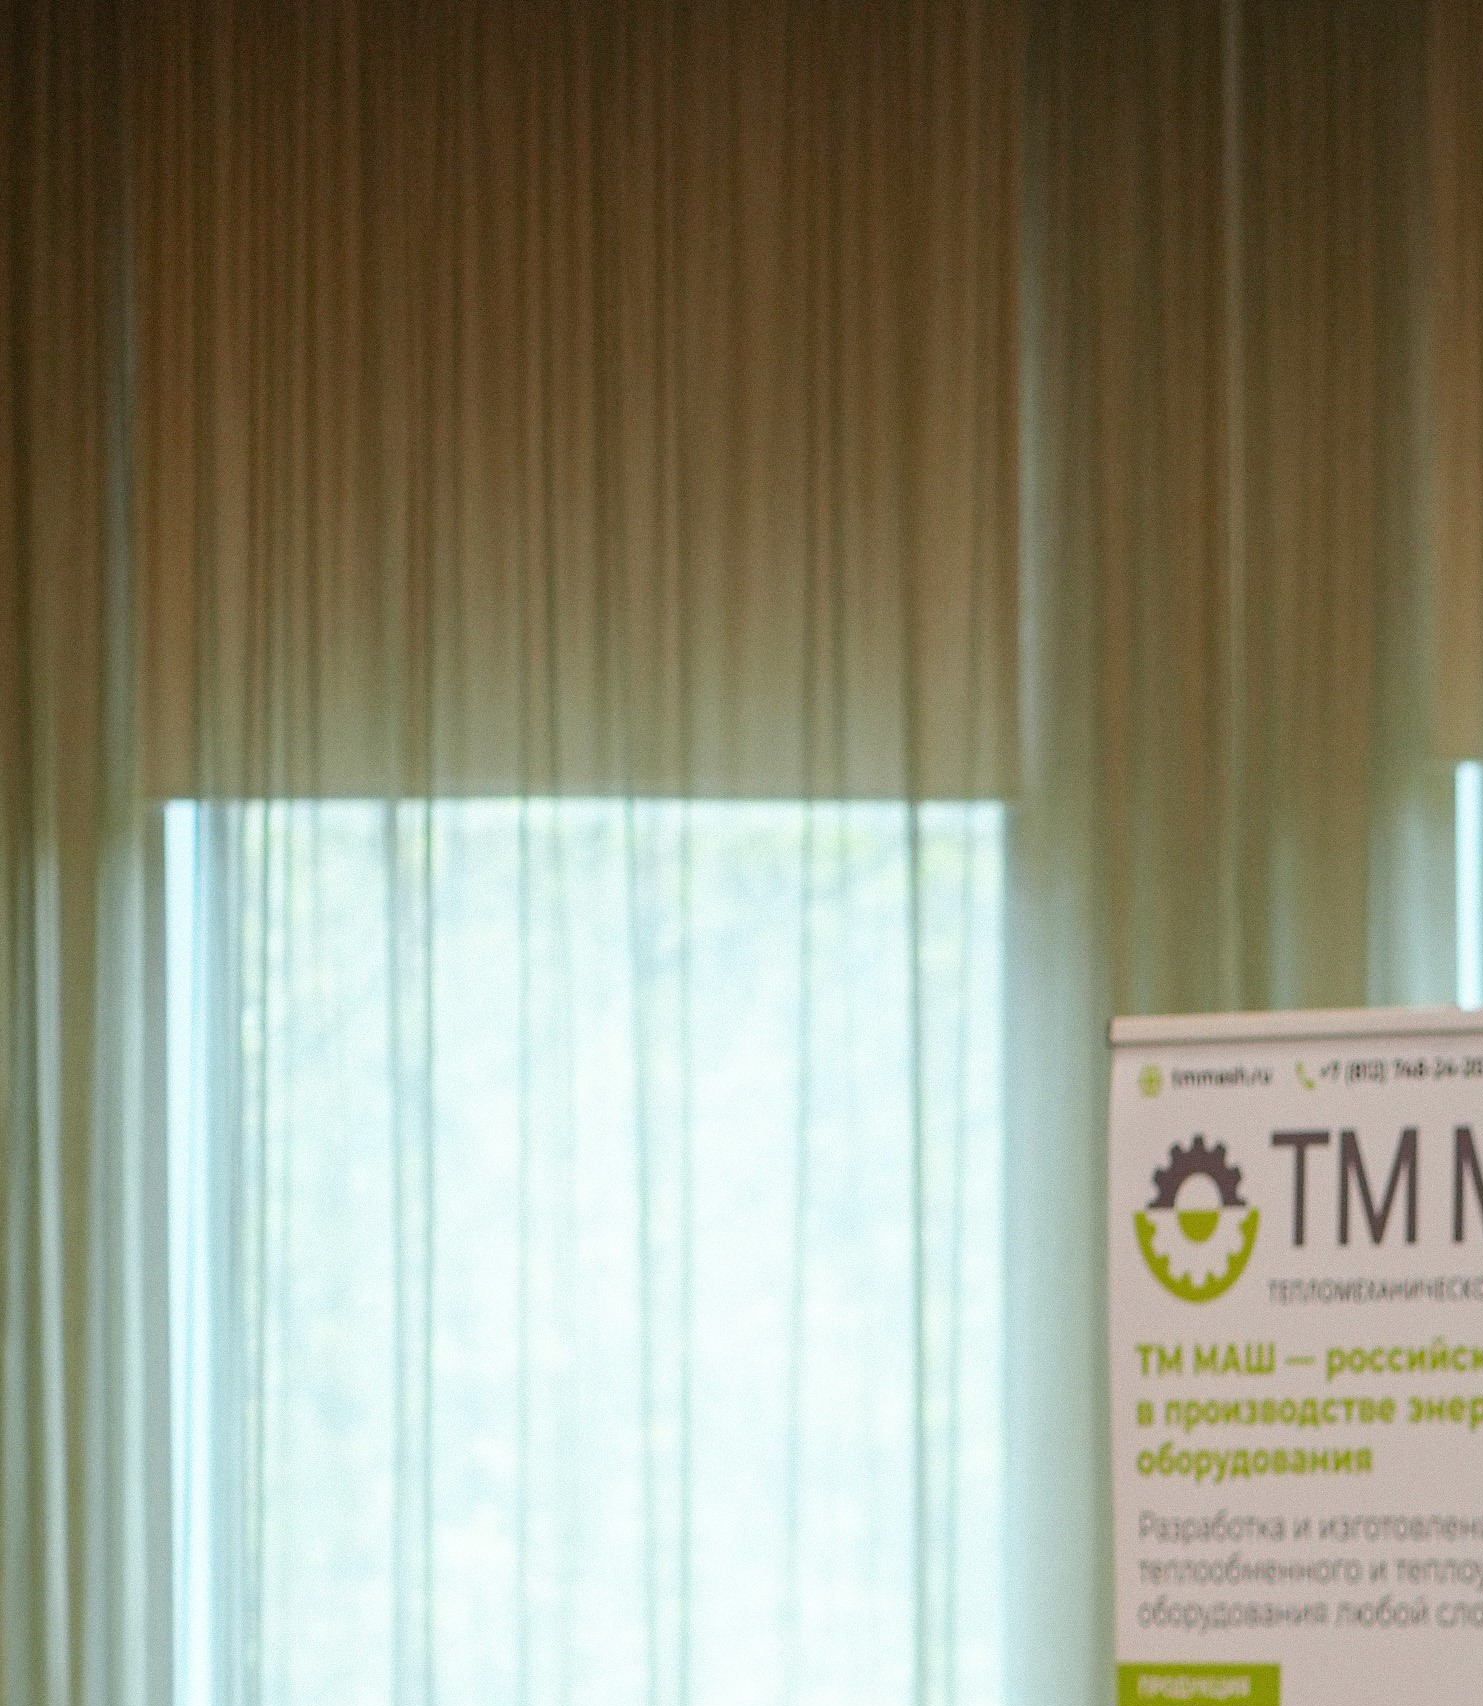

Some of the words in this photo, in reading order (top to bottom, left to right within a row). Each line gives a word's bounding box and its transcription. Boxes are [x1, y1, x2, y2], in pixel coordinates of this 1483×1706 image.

[1270, 1127, 1418, 1246] ТМ
[1136, 1343, 1182, 1376] ТМ
[1193, 1342, 1275, 1375] МАШ
[1137, 1402, 1153, 1425] в
[1165, 1396, 1395, 1432] производстве
[1137, 1442, 1374, 1484] оборудования
[1138, 1511, 1285, 1549] Разработка
[1137, 1554, 1361, 1588] теплообменного
[1137, 1595, 1330, 1633] оборудования
[1335, 1597, 1429, 1629] любой
